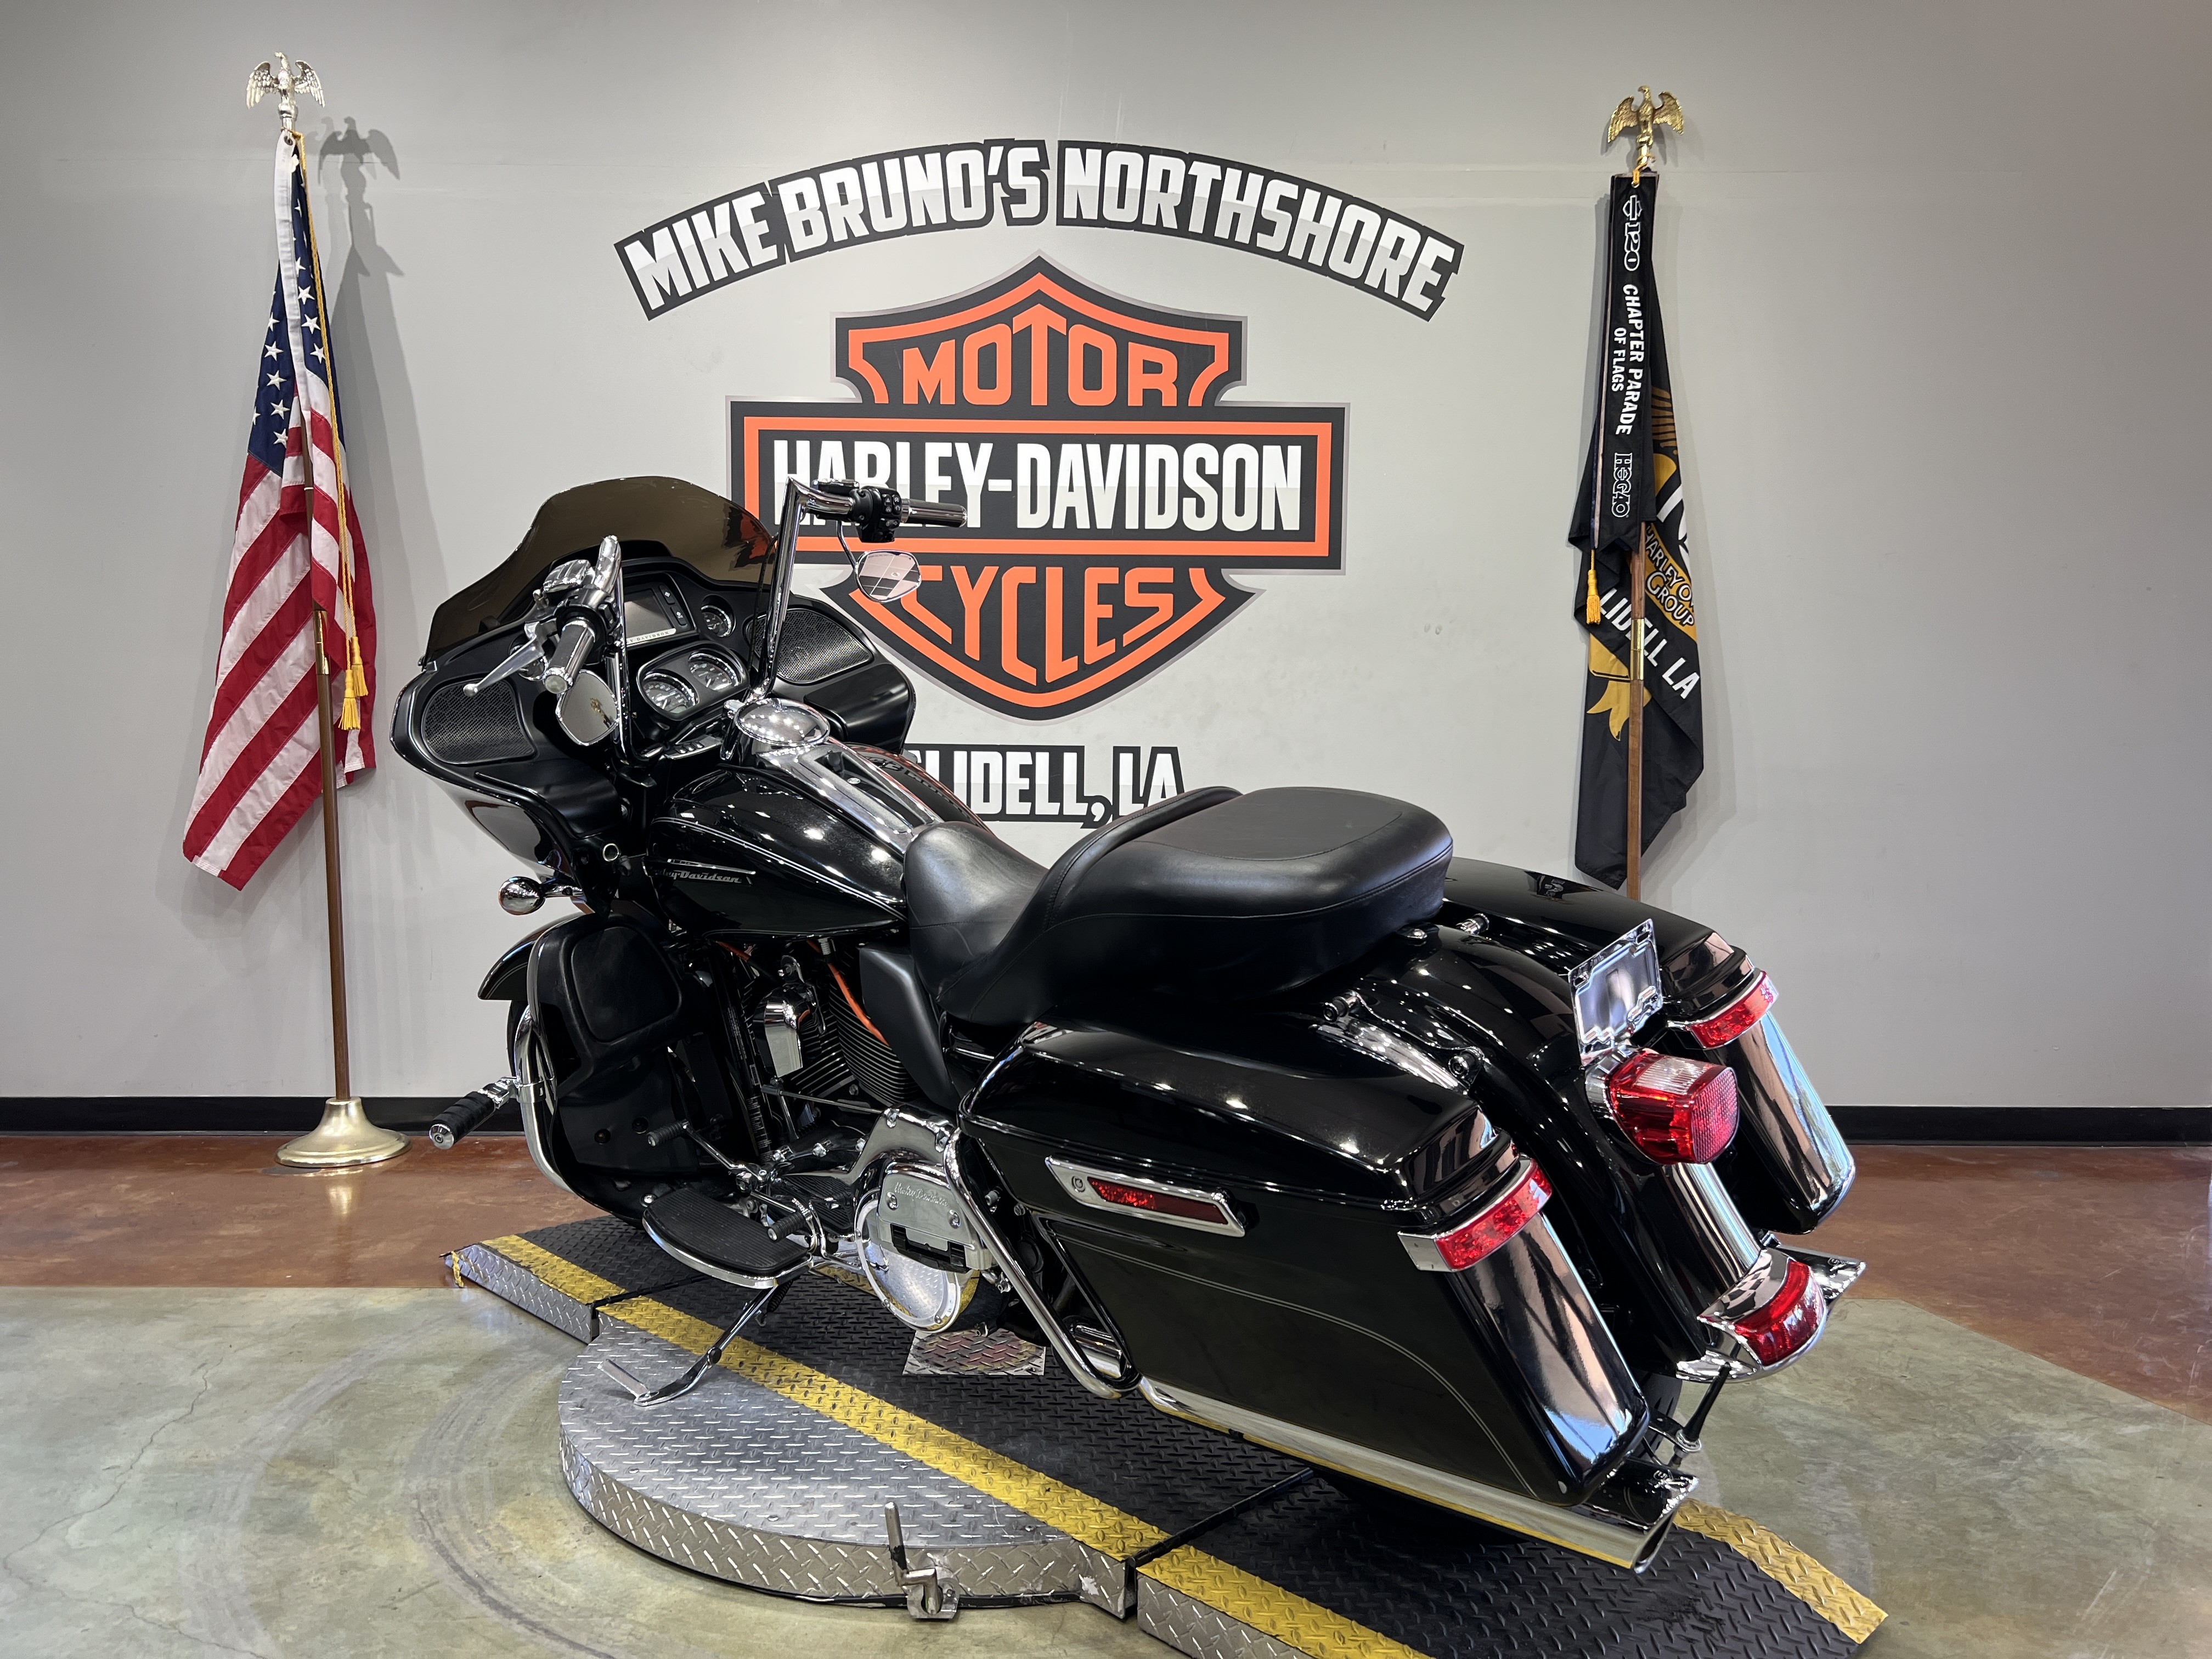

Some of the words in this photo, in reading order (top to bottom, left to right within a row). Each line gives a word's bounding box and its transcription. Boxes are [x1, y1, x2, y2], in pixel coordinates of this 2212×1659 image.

[623, 190, 778, 311] MIKE
[777, 147, 1047, 254] BRUNO'S
[1065, 147, 1456, 313] NORTHSHORE
[1623, 221, 1642, 272] 120
[902, 302, 1178, 407] MOTOR
[1613, 328, 1627, 345] OF
[1623, 284, 1644, 362] CHAPTER
[1611, 349, 1626, 392] FLAGS
[1615, 368, 1644, 435] PARADE
[900, 565, 1175, 686] CYCLES
[1647, 571, 1694, 626] GROUP
[1662, 657, 1700, 699] LA
[915, 750, 1105, 823] IDELL,
[1119, 752, 1177, 816] LA
